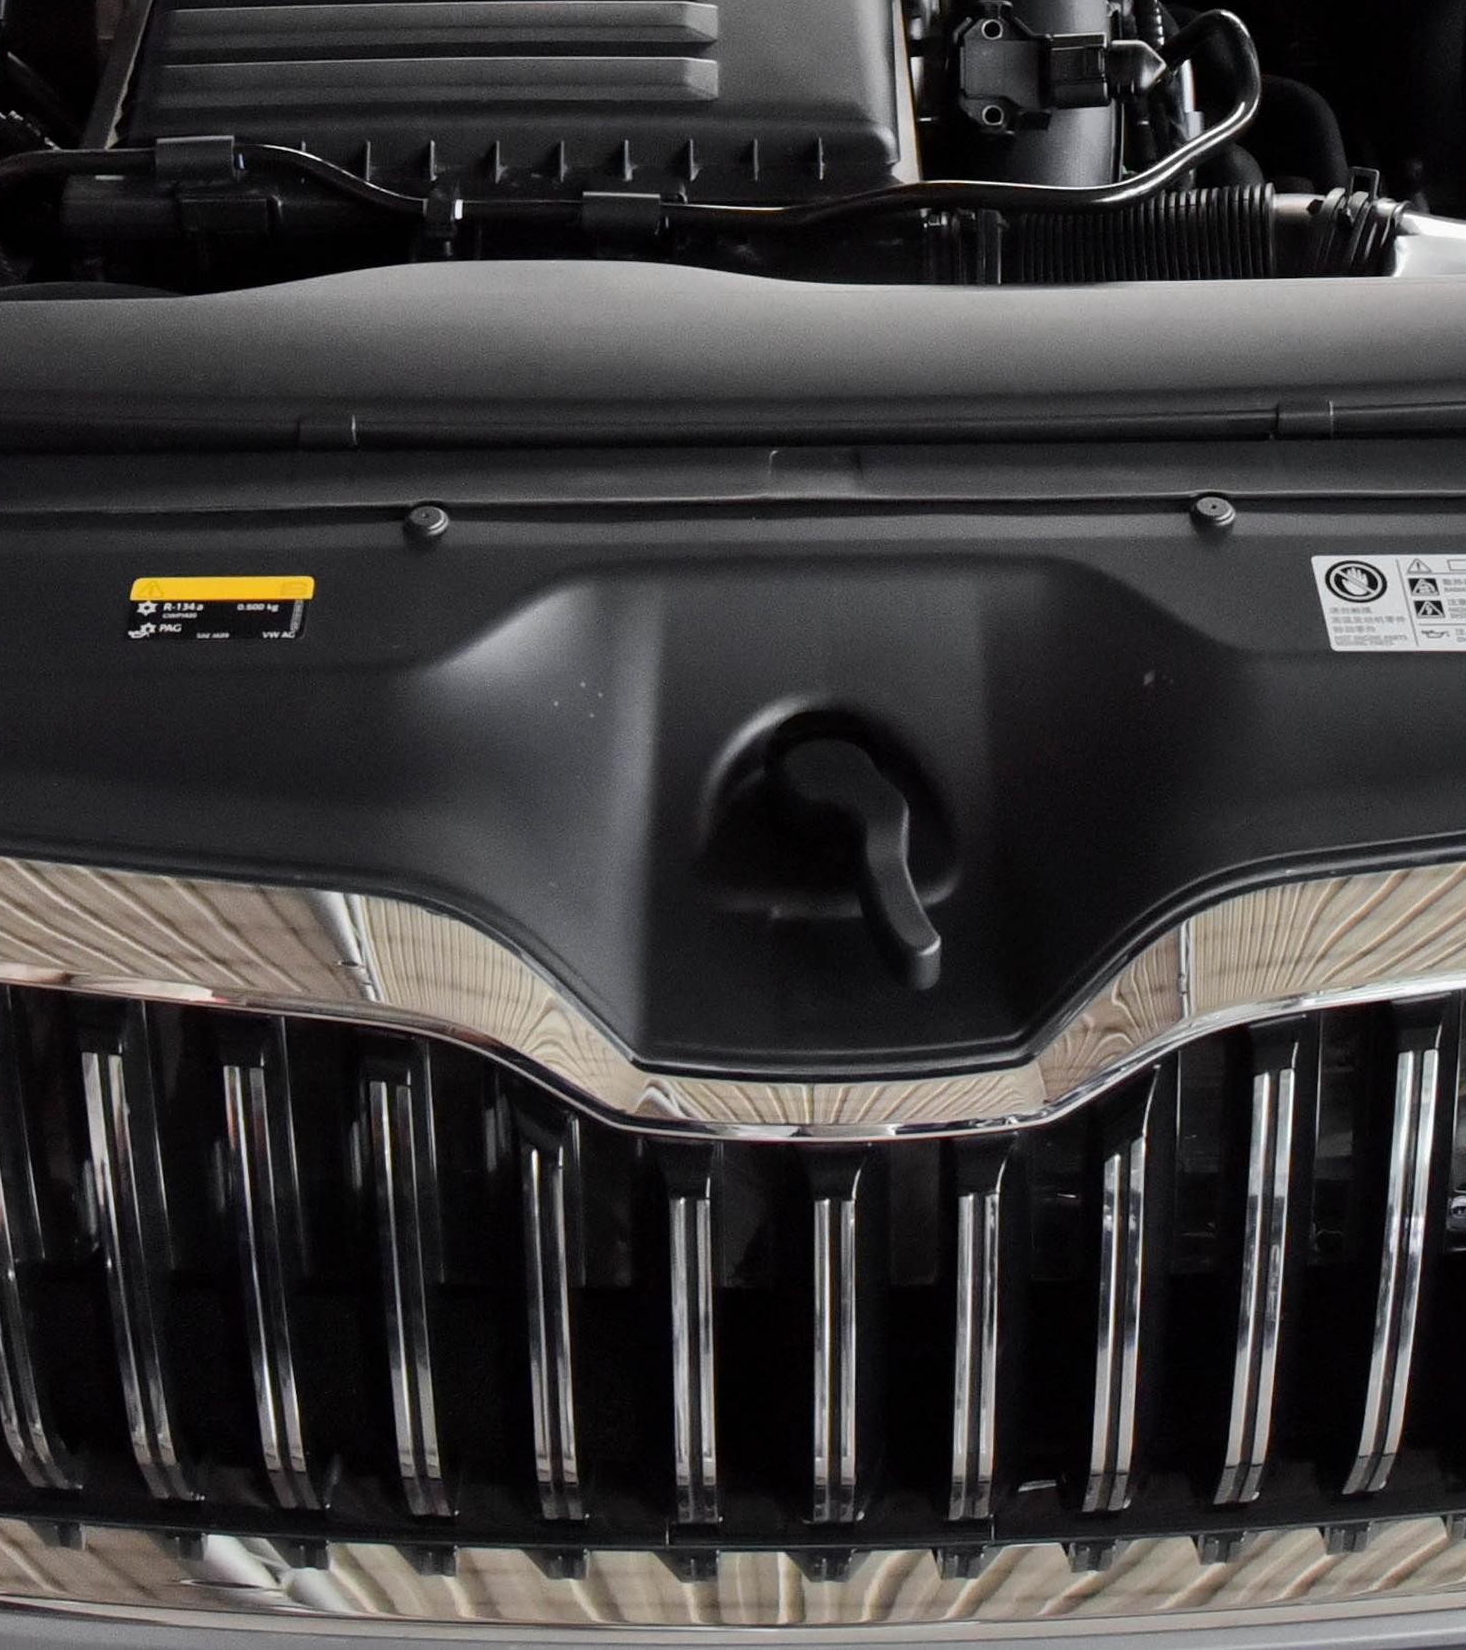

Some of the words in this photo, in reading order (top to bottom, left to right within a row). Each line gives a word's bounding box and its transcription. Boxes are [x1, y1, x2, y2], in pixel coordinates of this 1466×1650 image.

[266, 603, 280, 613] kg
[159, 623, 182, 633] PAG
[262, 631, 280, 639] VW
